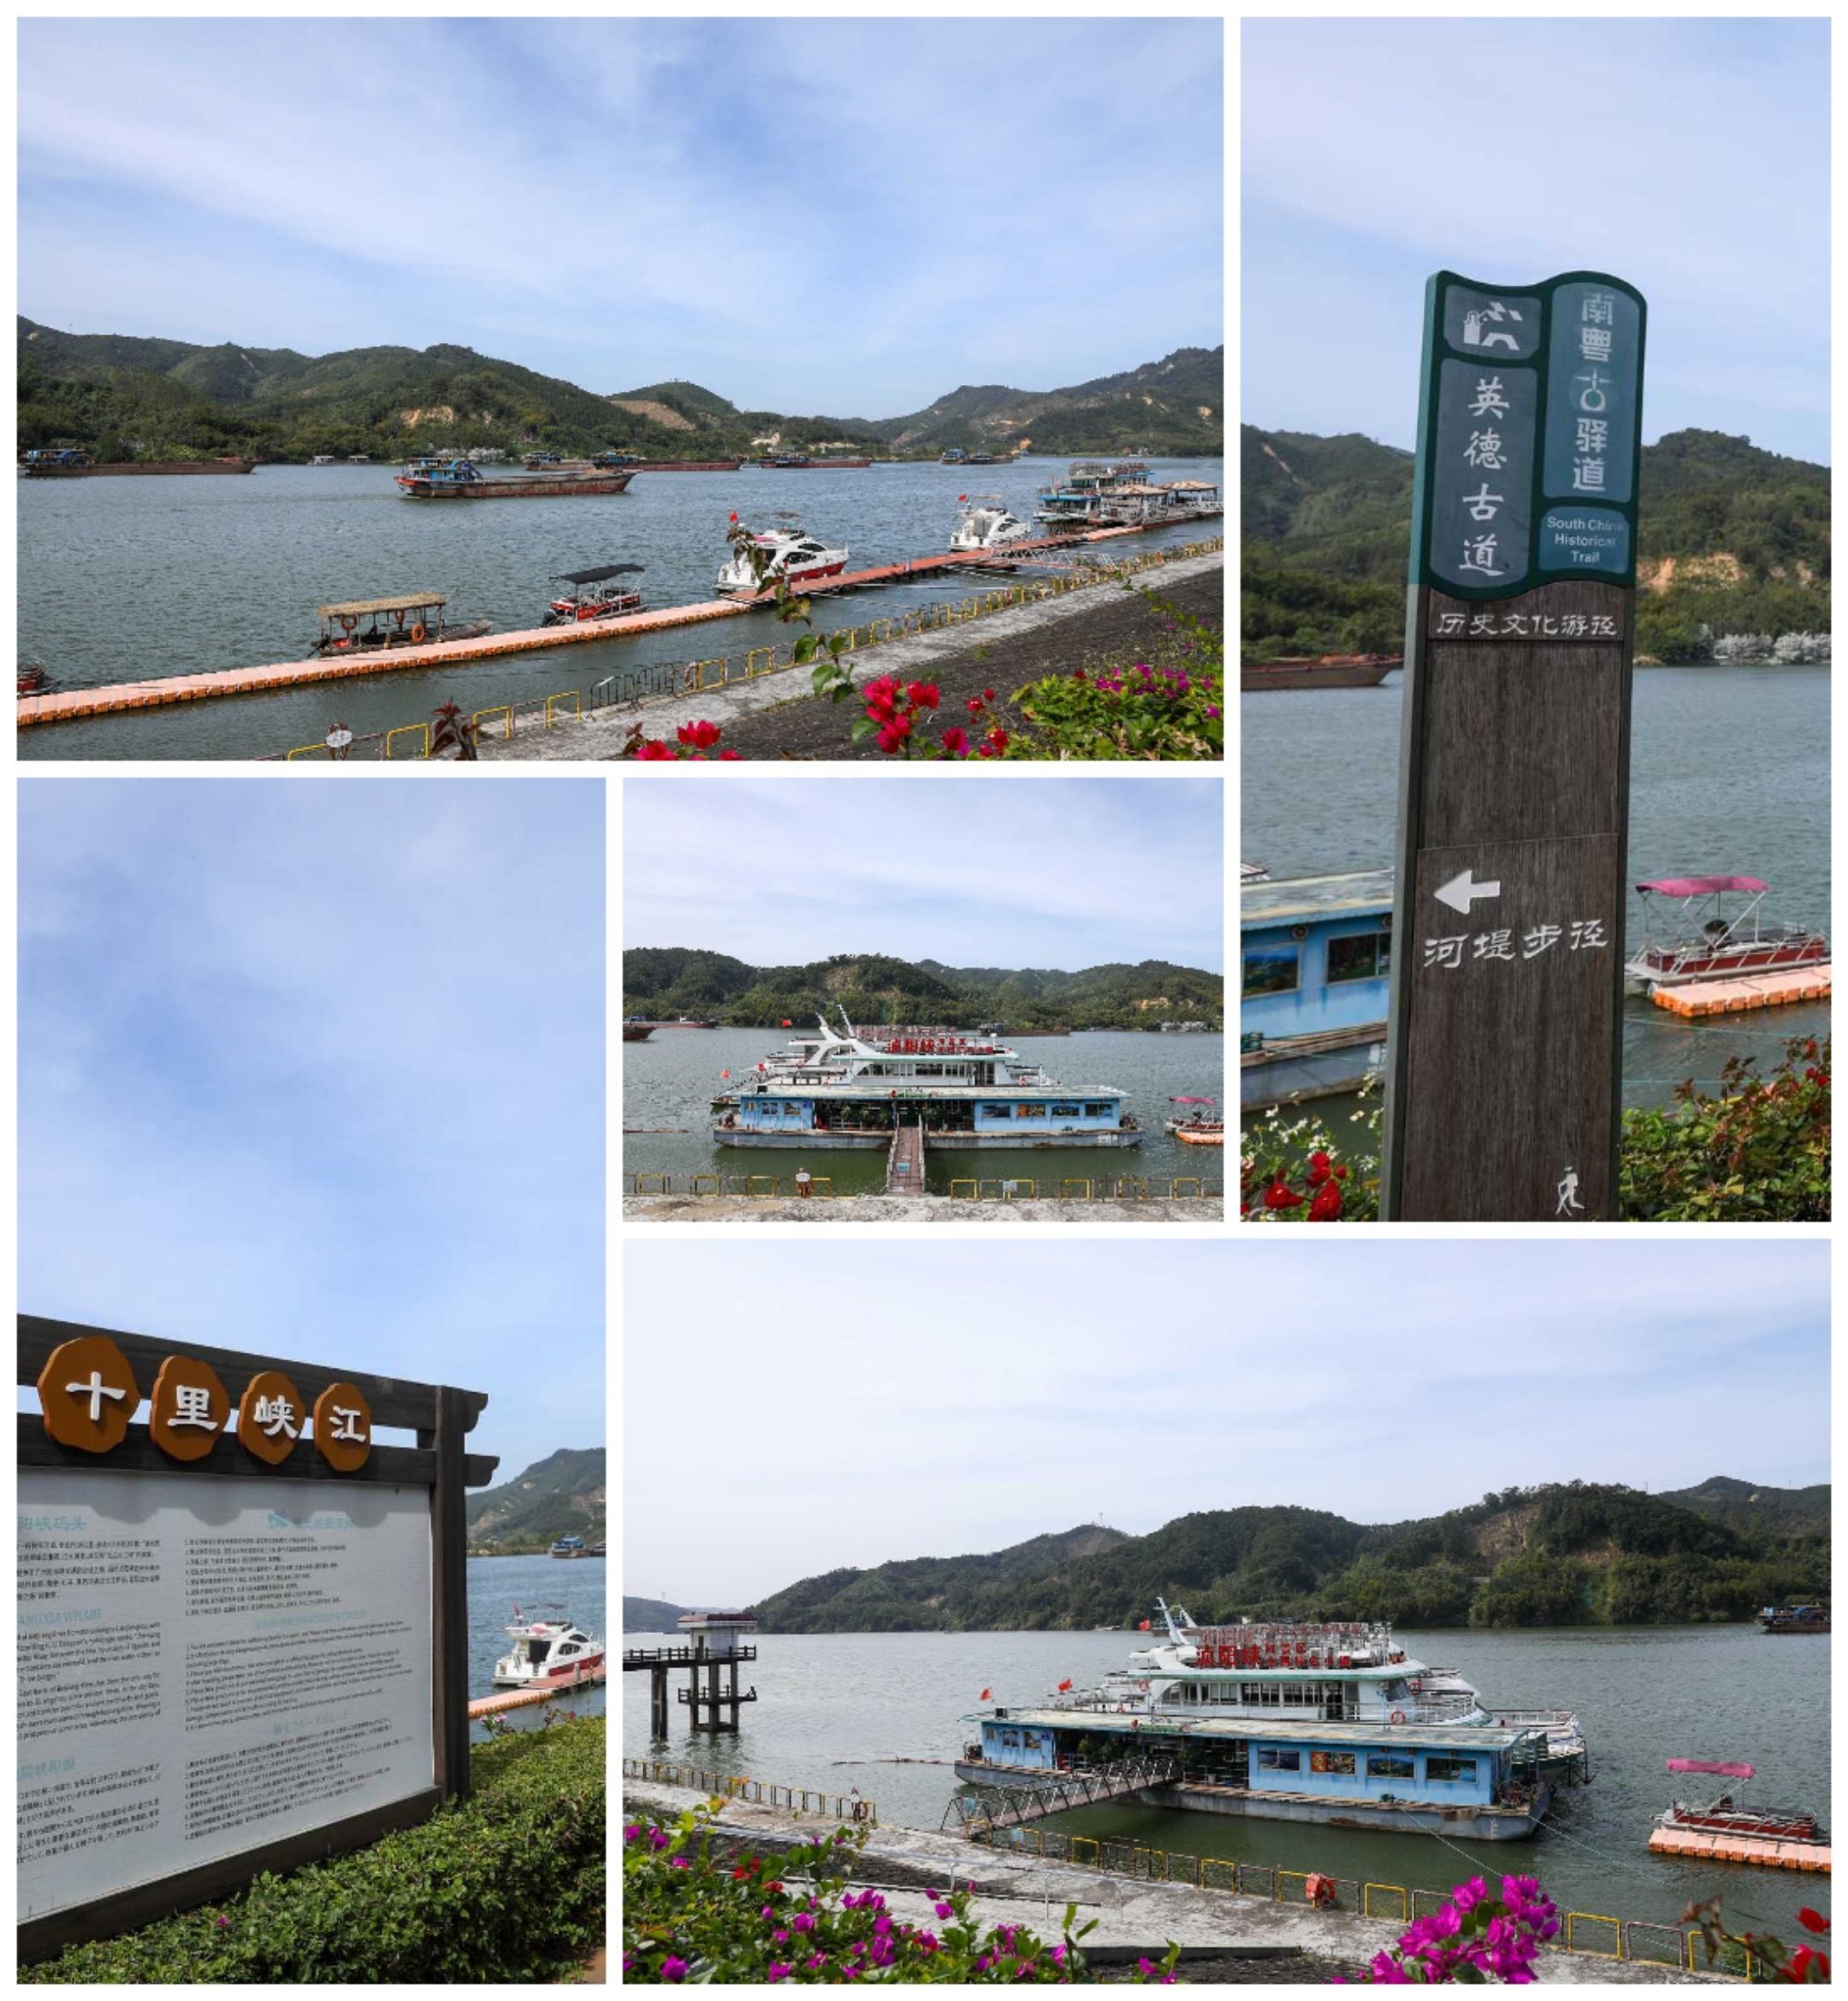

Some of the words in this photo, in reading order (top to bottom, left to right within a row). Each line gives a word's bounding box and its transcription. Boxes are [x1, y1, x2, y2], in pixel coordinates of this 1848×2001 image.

[1459, 376, 1511, 577] 英德古道
[1547, 516, 1585, 530] South
[1555, 533, 1616, 548] Historical
[1571, 550, 1600, 563] Trail
[1436, 613, 1618, 636] 历史文化游径
[1423, 919, 1608, 968] 河堤步径
[65, 1371, 368, 1444] 十里峡江
